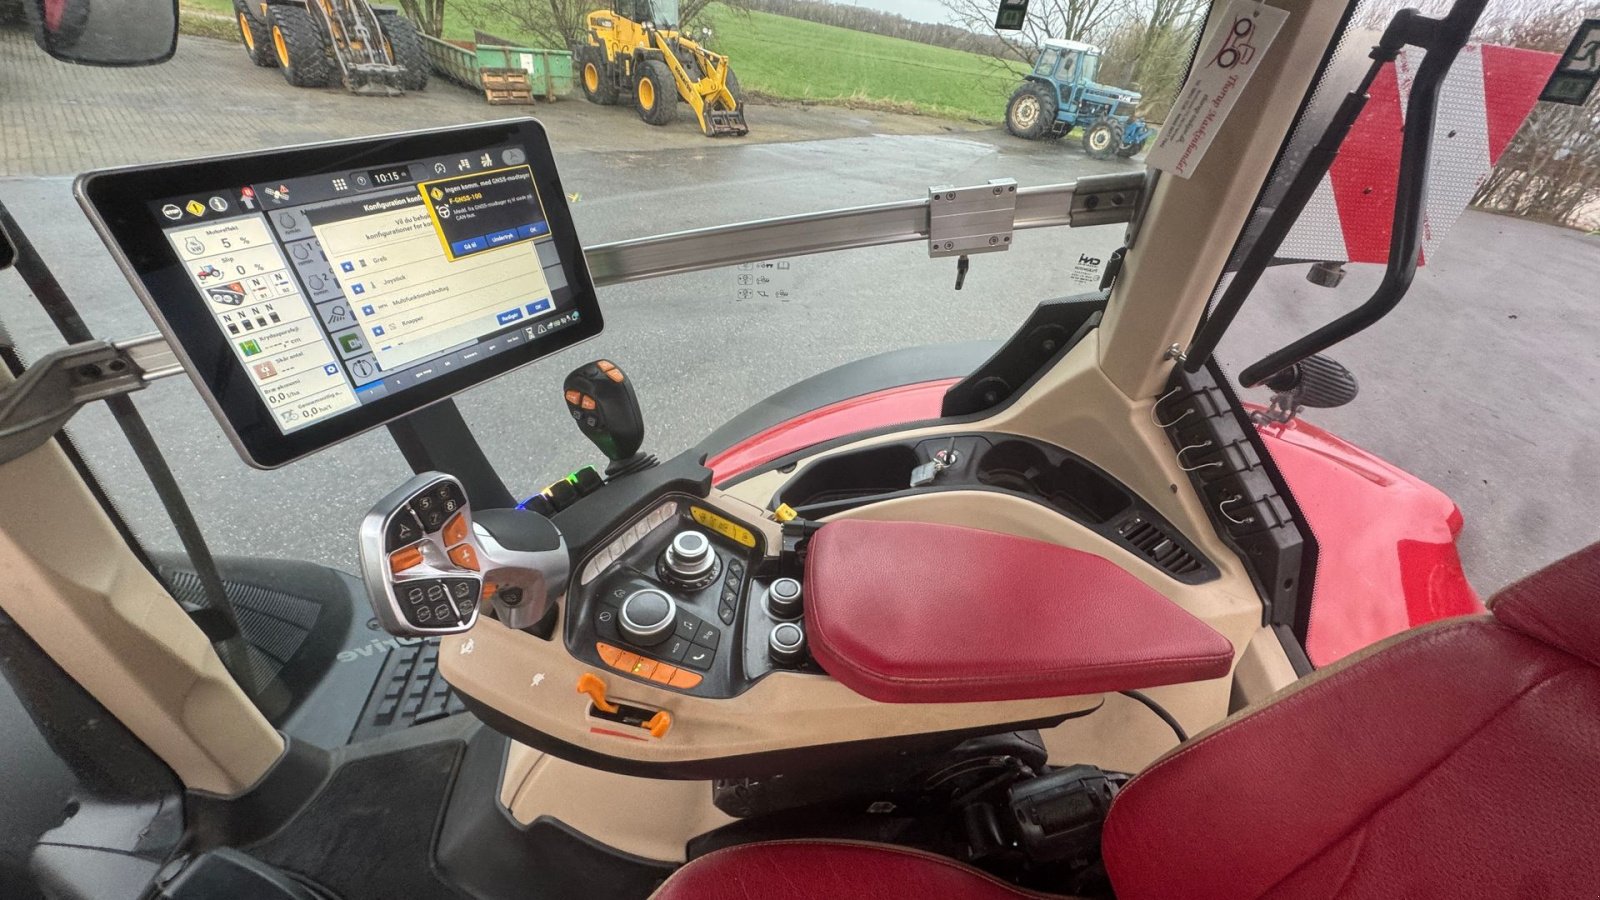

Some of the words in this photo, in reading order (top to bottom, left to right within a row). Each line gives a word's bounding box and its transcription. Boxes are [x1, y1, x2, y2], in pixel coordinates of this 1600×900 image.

[1212, 74, 1239, 108] Thorup
[374, 171, 400, 183] 10:15
[444, 185, 461, 195] Ingen
[480, 179, 491, 187] med
[363, 197, 407, 212] Konfiguration
[448, 192, 483, 205] F-GNSS-100
[394, 218, 404, 226] Vil
[365, 225, 413, 241] konfigurationer
[221, 238, 231, 248] 5
[240, 236, 250, 244] %
[307, 242, 313, 251] 1
[221, 257, 234, 265] Slip
[236, 265, 246, 275] 0
[254, 263, 264, 271] %
[252, 278, 260, 286] N
[383, 275, 407, 286] Joystick
[265, 303, 274, 311] N
[401, 316, 424, 327] Knapper
[268, 392, 286, 404] 0,0
[302, 406, 318, 418] 0,0
